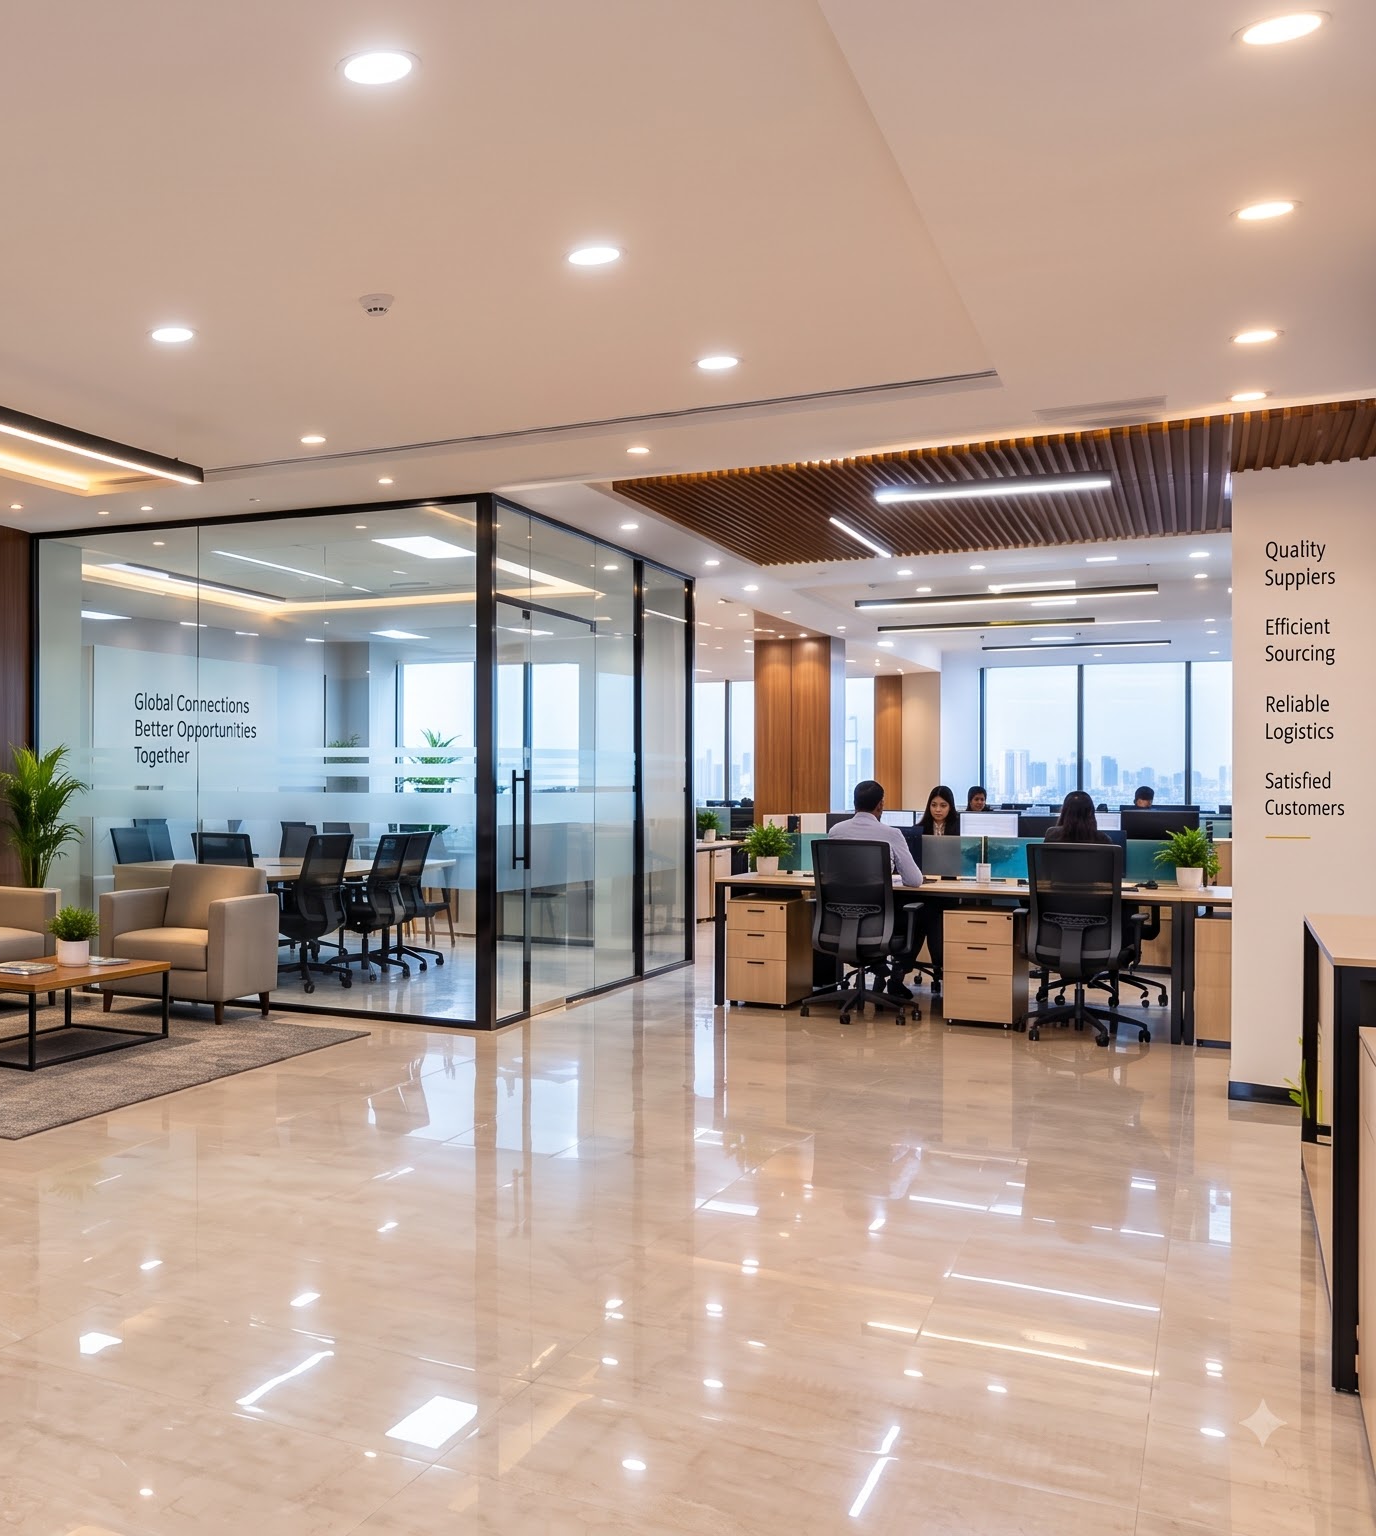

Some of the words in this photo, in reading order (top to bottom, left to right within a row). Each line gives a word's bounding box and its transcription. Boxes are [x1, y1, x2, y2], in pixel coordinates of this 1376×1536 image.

[1265, 539, 1326, 563] Quality
[1264, 567, 1336, 591] Suppiers
[1265, 617, 1331, 636] Efficient
[1265, 644, 1336, 666] Sourcing
[134, 692, 174, 712] Global
[176, 694, 250, 714] Connections
[1265, 694, 1330, 713] Reliable
[134, 719, 174, 738] Better
[176, 720, 257, 743] Opportunities
[1265, 722, 1334, 745] Logistics
[133, 746, 190, 769] Together
[1265, 770, 1331, 790] Satisfied
[1265, 798, 1345, 816] Customers
